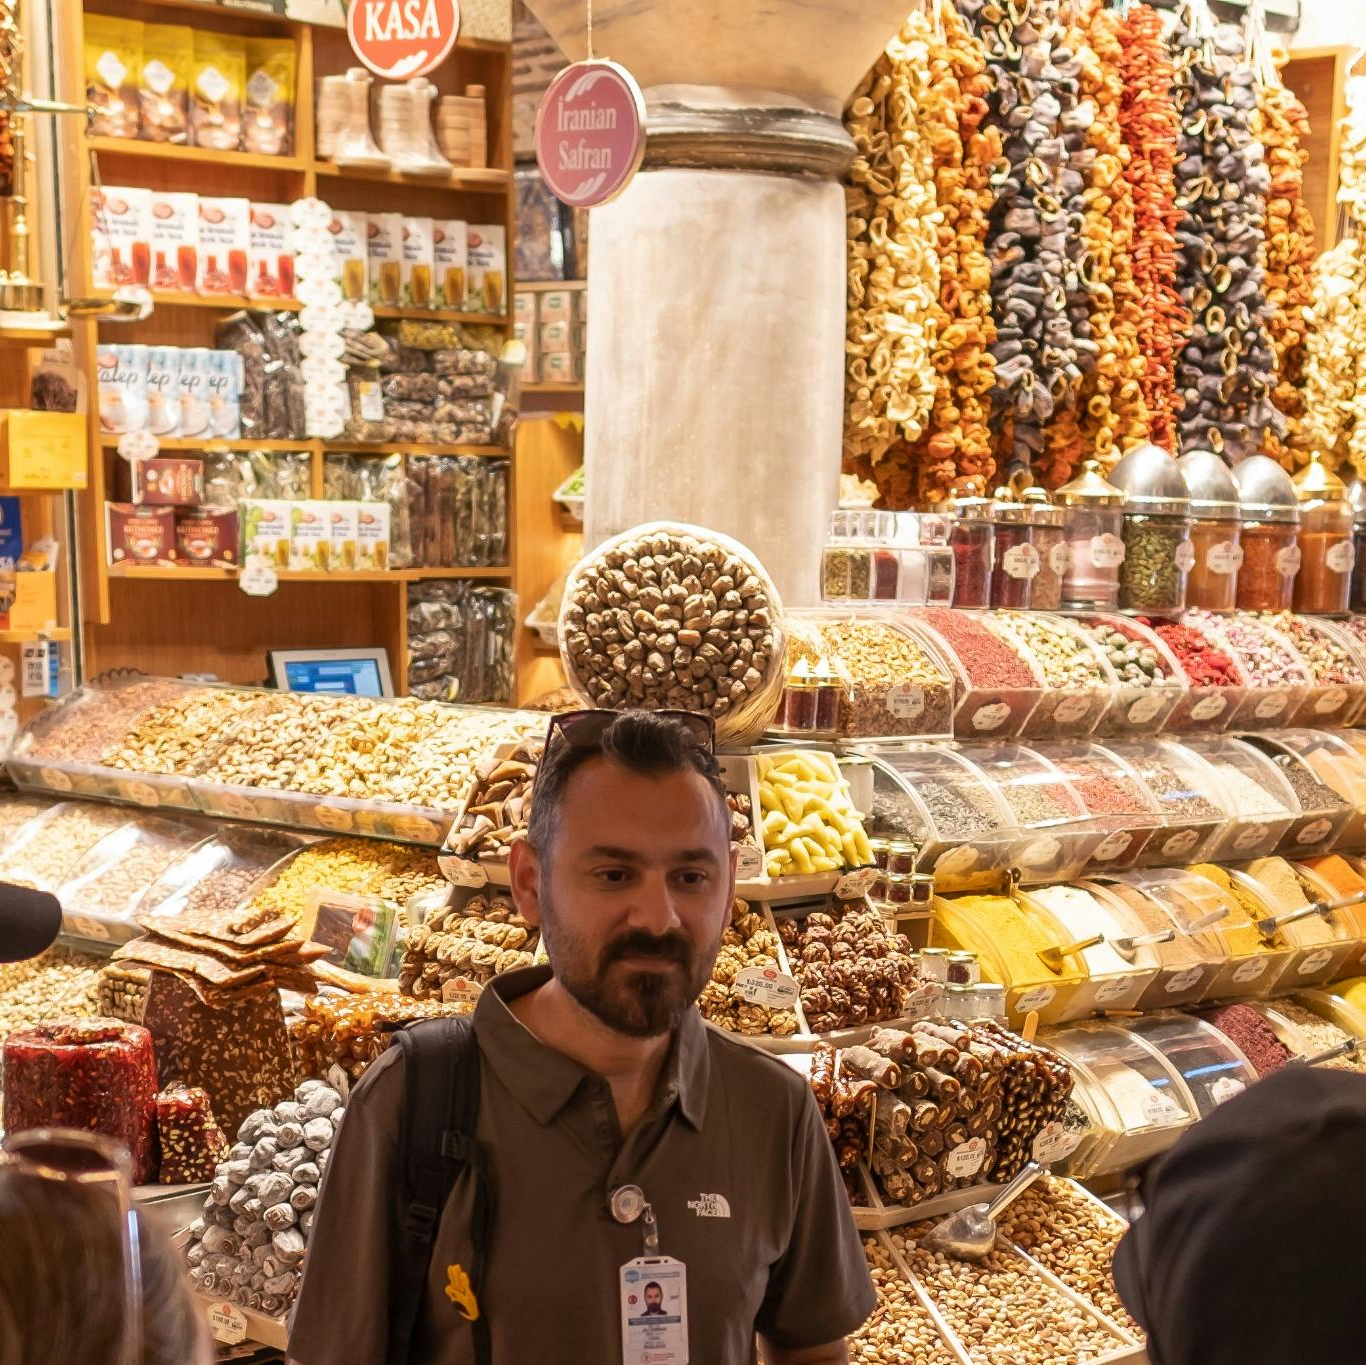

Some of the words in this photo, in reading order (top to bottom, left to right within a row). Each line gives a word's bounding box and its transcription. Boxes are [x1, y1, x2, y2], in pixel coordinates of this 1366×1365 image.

[365, 0, 441, 42] KASA
[557, 96, 617, 132] İranian
[558, 139, 612, 171] Safran
[688, 1200, 718, 1210] NORTH
[700, 1193, 717, 1201] THE
[696, 1208, 718, 1217] FACE
